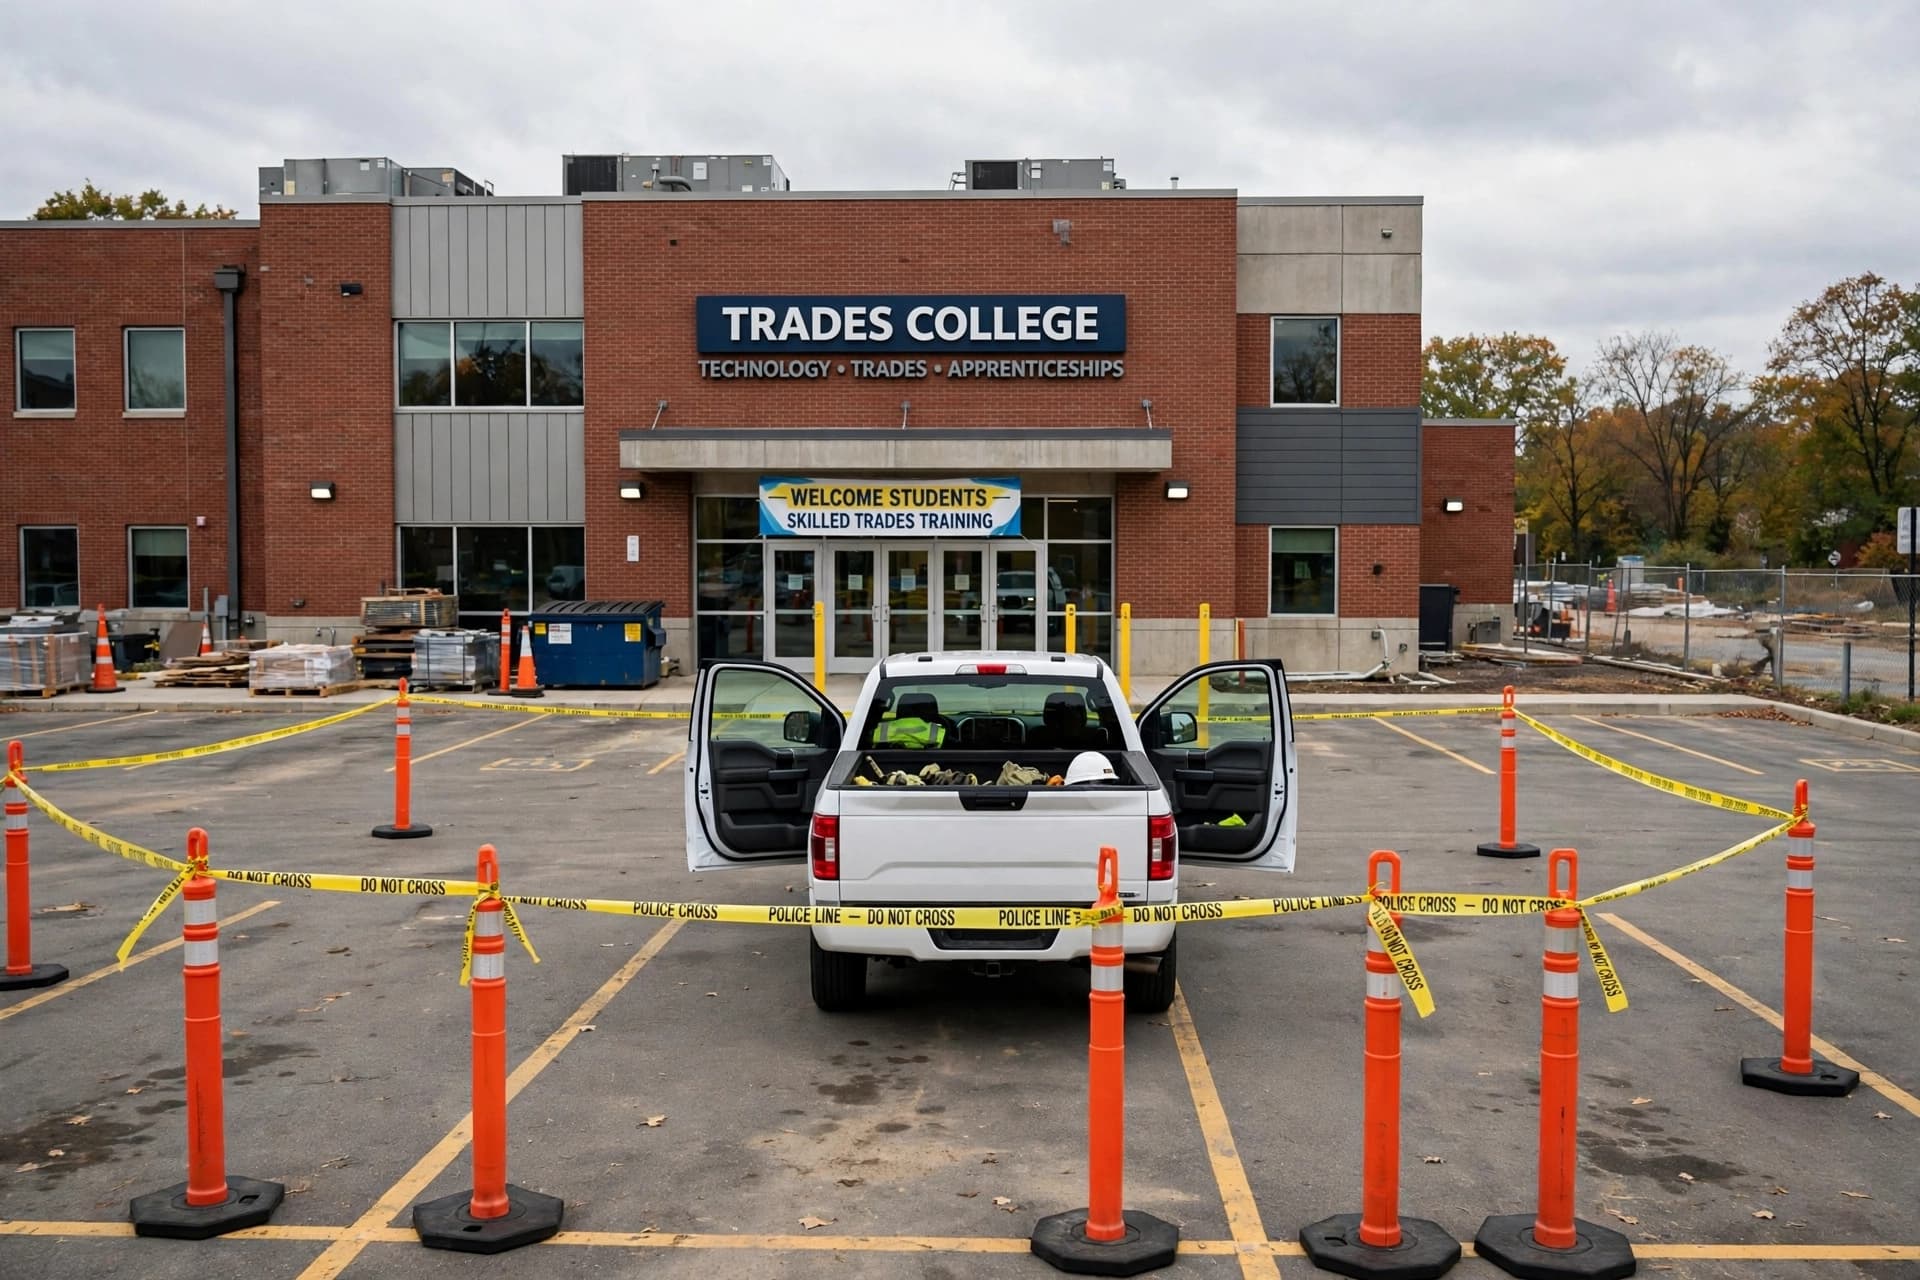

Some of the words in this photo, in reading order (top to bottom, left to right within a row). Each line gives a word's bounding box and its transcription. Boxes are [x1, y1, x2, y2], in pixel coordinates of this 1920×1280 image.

[722, 305, 894, 342] TRADES
[906, 305, 1099, 342] COLLEGE
[698, 359, 832, 378] TECHNOLOGY
[851, 359, 928, 378] TRADES
[947, 359, 1125, 378] APPRENTICESHIPS
[790, 488, 884, 507] WELCOME
[889, 488, 988, 507] STUDENTS
[787, 512, 851, 529] SKILLED
[855, 512, 916, 529] TRADES
[919, 512, 993, 529] TRAINING
[246, 871, 271, 883] NOT
[272, 873, 312, 889] CROSS
[361, 877, 376, 892] DO
[381, 878, 404, 894] NOT
[407, 880, 446, 896] CROSS
[633, 902, 675, 917] POLICE
[678, 903, 718, 919] CROSS
[1133, 907, 1150, 922] DO
[1154, 905, 1178, 921] NOT
[1182, 903, 1223, 920] CROSS
[1273, 896, 1317, 912] POLICE
[1418, 896, 1457, 913] CROSS
[1482, 897, 1498, 914] DO
[1502, 898, 1525, 914] NOT
[1529, 899, 1566, 912] CROS
[768, 906, 811, 923] POLICE
[815, 908, 841, 924] LINE
[868, 908, 884, 925] DO
[888, 909, 912, 925] NOT
[915, 909, 955, 926] CROSS
[999, 909, 1040, 926] POLICE
[1045, 909, 1071, 926] LINE
[1387, 937, 1409, 957] NOT
[1396, 958, 1424, 991] CROSS
